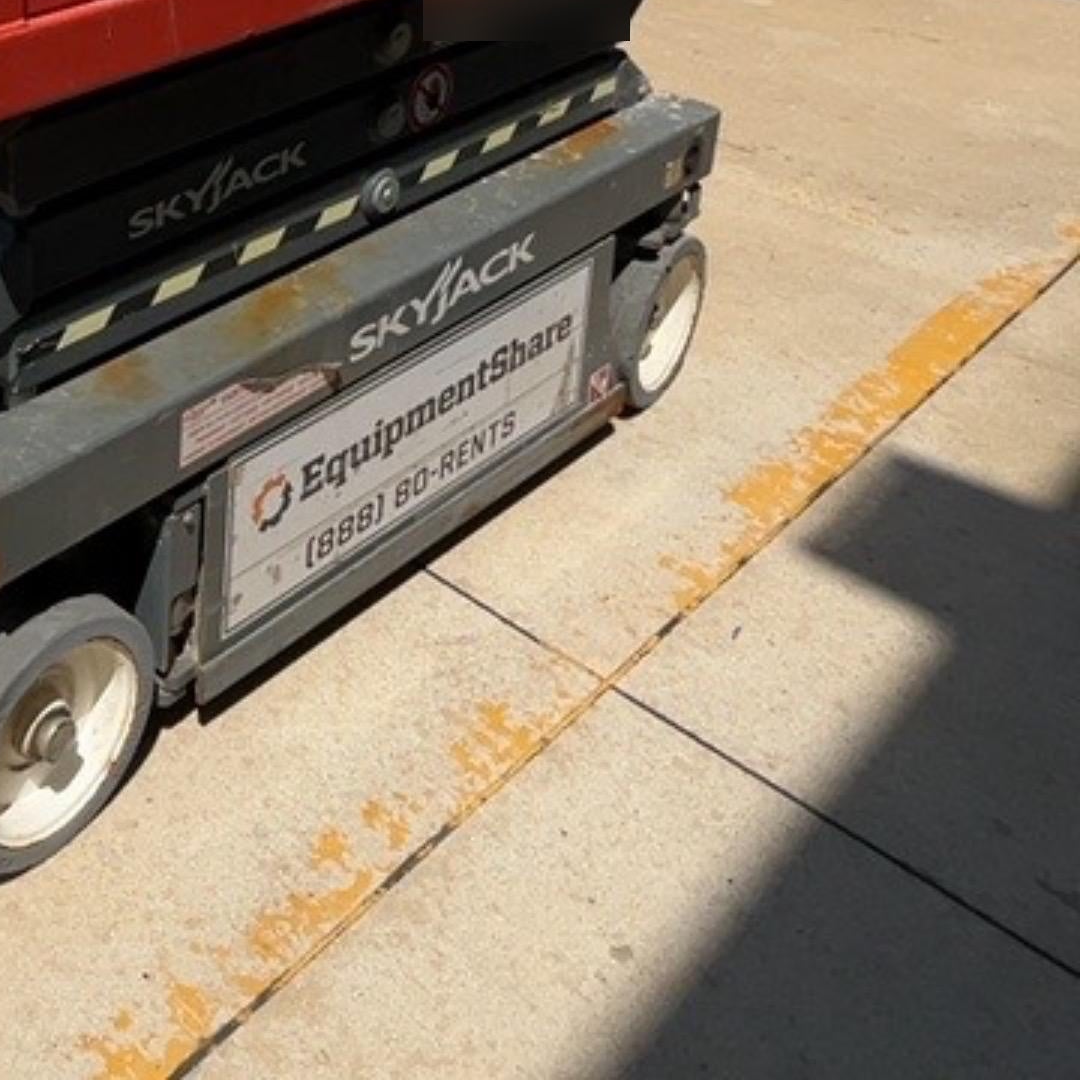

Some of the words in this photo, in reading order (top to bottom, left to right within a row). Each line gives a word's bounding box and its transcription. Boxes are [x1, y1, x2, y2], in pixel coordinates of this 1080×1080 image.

[128, 141, 306, 238] SKYJACK
[347, 230, 537, 365] SKYJACK
[299, 313, 573, 502] EquipmentShare
[304, 495, 386, 570] (888)
